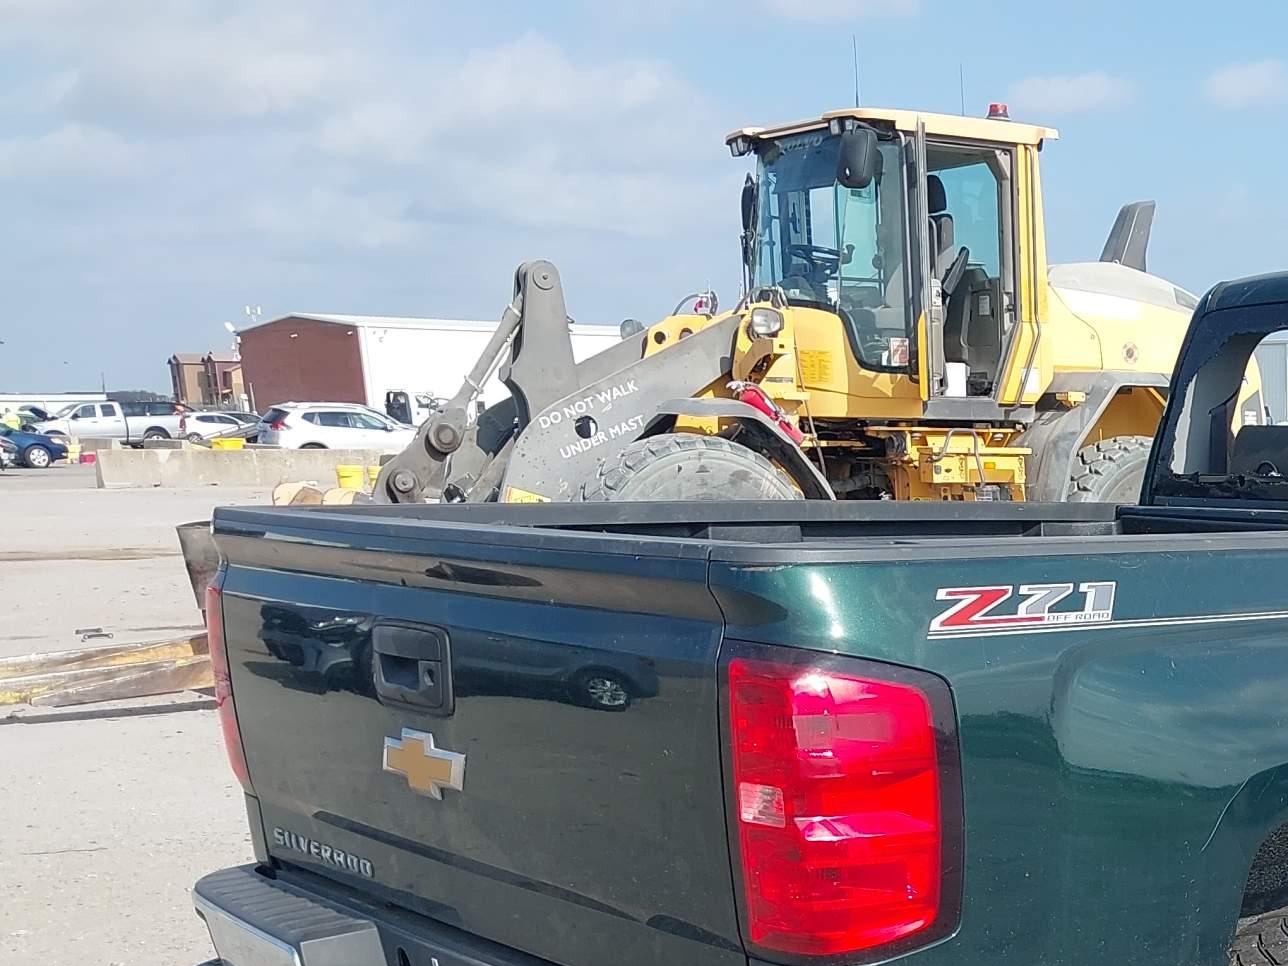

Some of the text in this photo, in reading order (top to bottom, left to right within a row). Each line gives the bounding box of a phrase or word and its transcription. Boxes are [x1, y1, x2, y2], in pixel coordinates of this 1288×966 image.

[539, 379, 639, 429] DO NOT WALK
[560, 414, 644, 459] UNDER MAST
[927, 580, 1117, 633] Z71
[1047, 610, 1111, 623] OFF ROAD
[272, 825, 375, 879] SILVERADO
